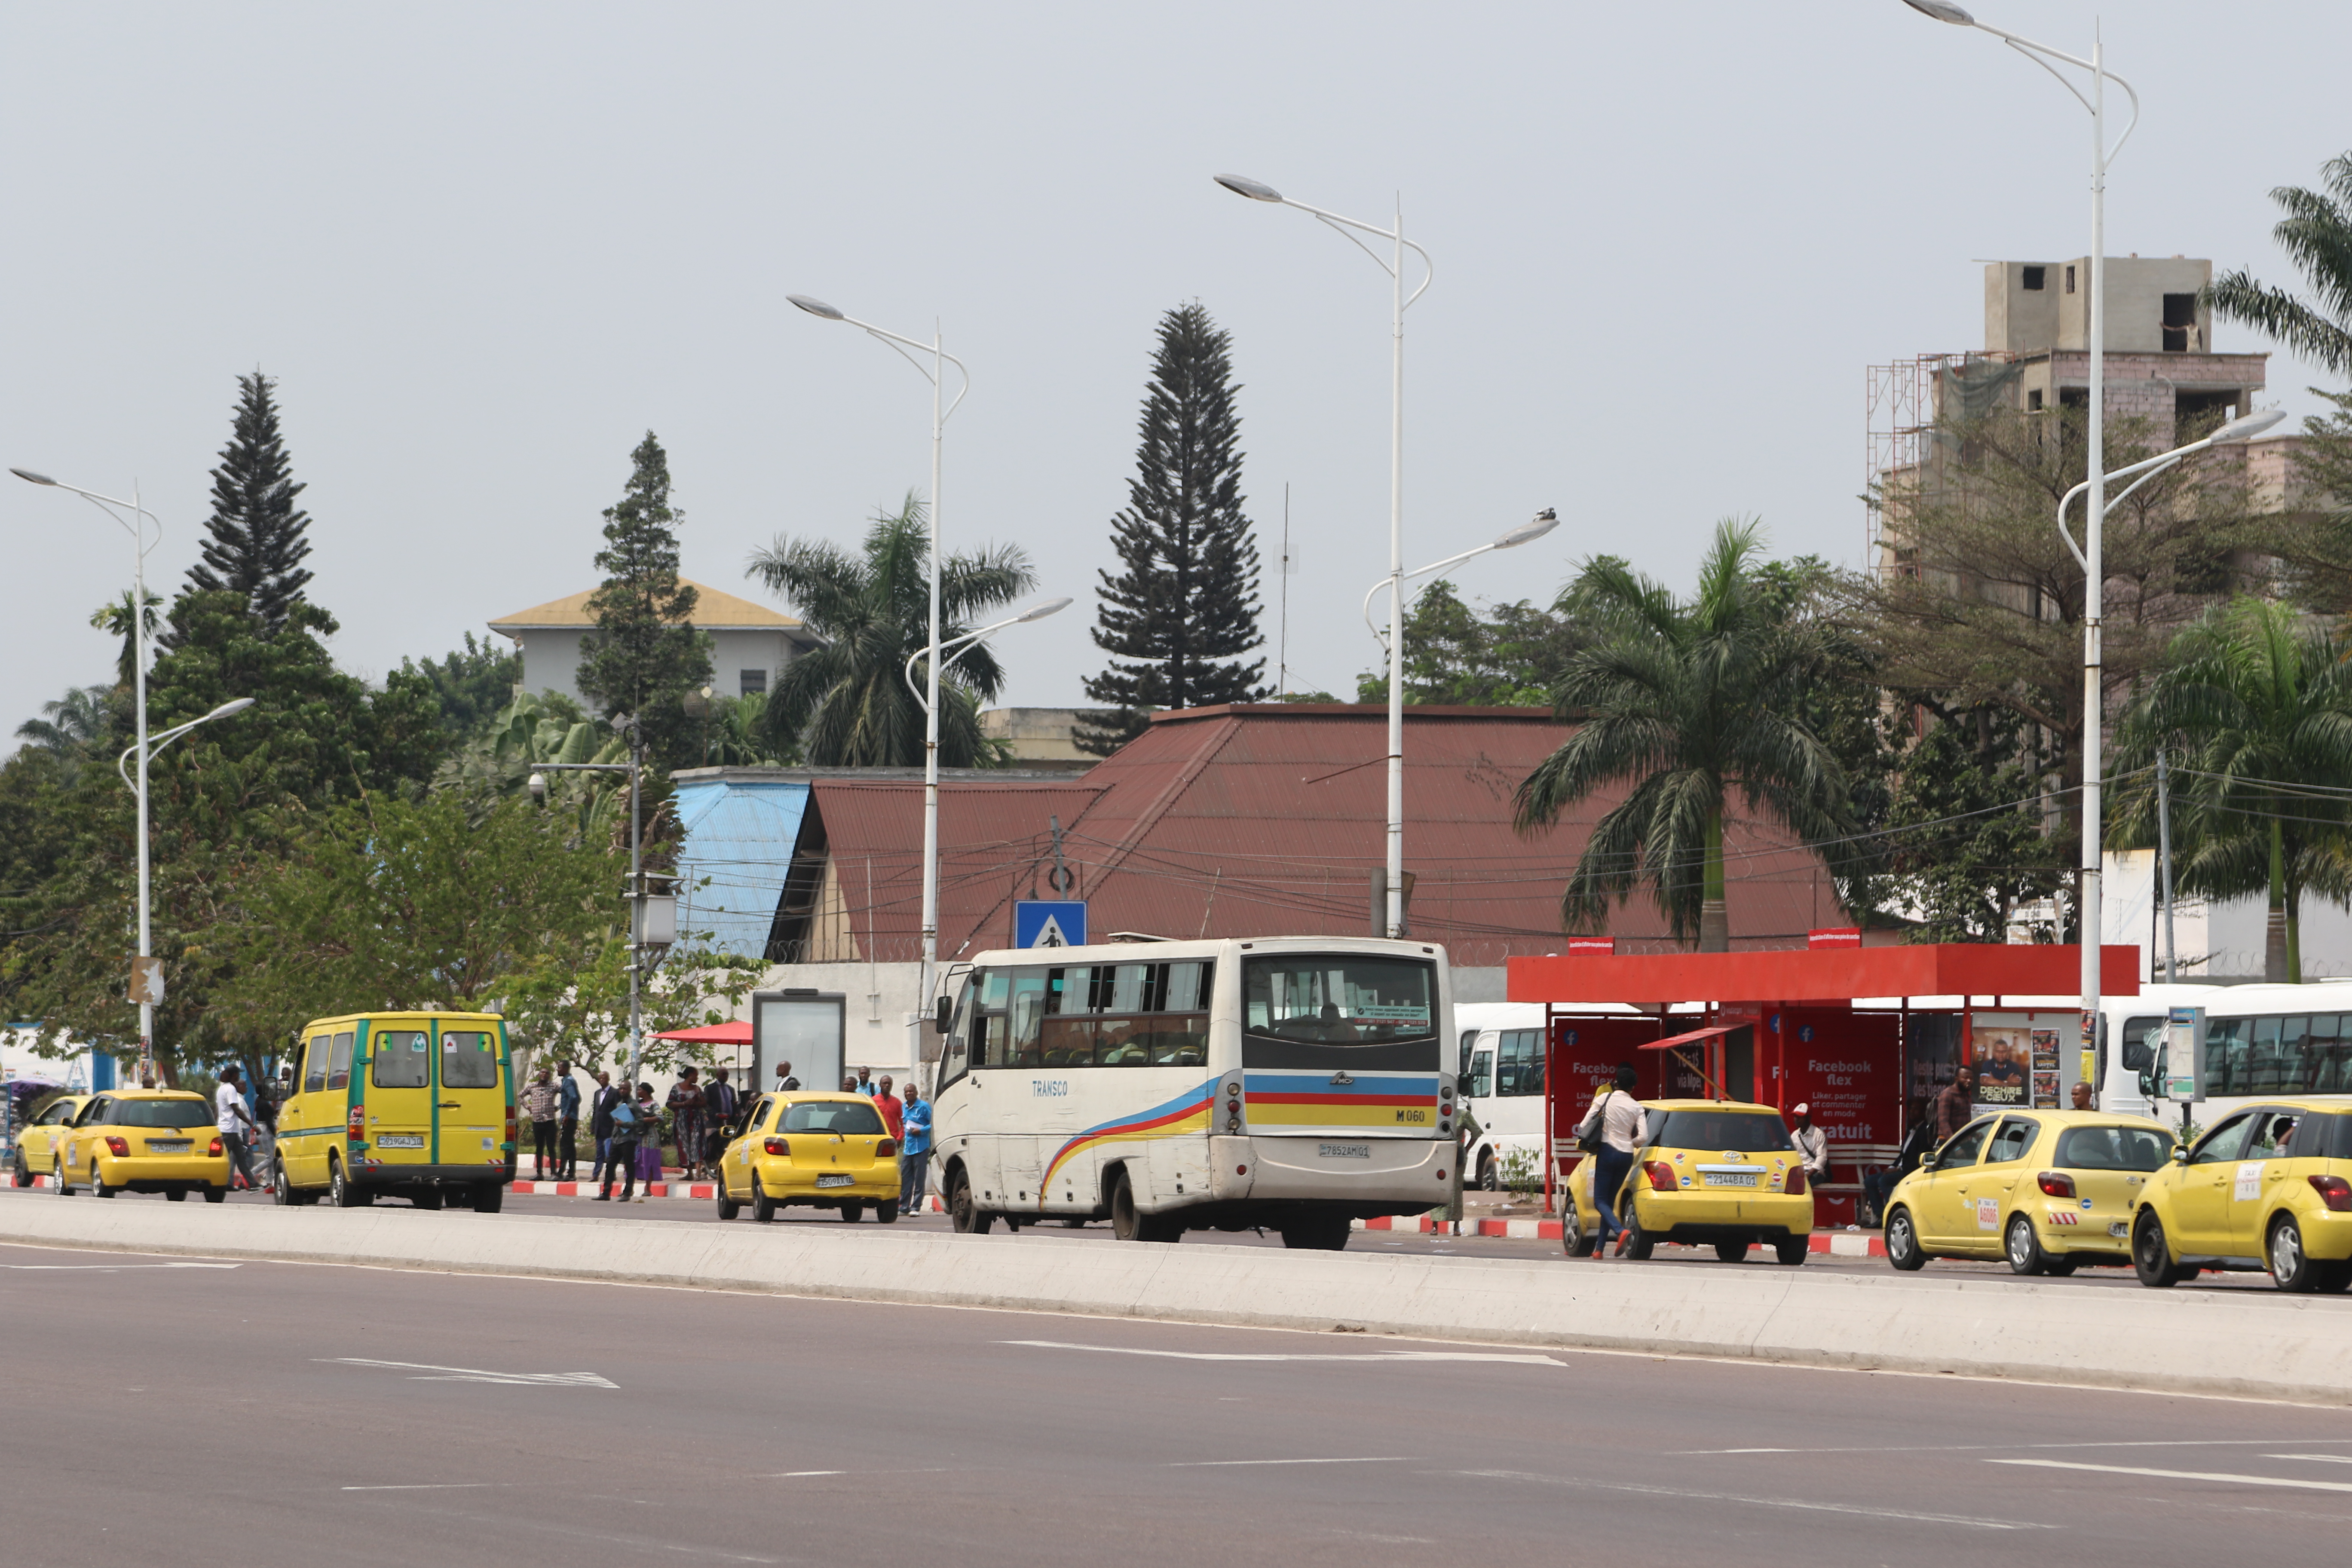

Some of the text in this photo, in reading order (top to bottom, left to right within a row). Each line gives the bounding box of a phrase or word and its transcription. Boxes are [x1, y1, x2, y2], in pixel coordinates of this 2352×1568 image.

[1809, 1059, 1871, 1072] Facebook
[1677, 1073, 1687, 1088] via
[1827, 1074, 1852, 1085] flex
[1032, 1080, 1068, 1097] TRANSCO
[1980, 1086, 2022, 1095] DECHIRE
[1834, 1093, 1867, 1102] partager
[1986, 1094, 2016, 1102] CIEUX
[1397, 1110, 1425, 1122] M 060
[1327, 1146, 1368, 1157] 7852AM 01
[1713, 1175, 1756, 1185] 2144BA 01
